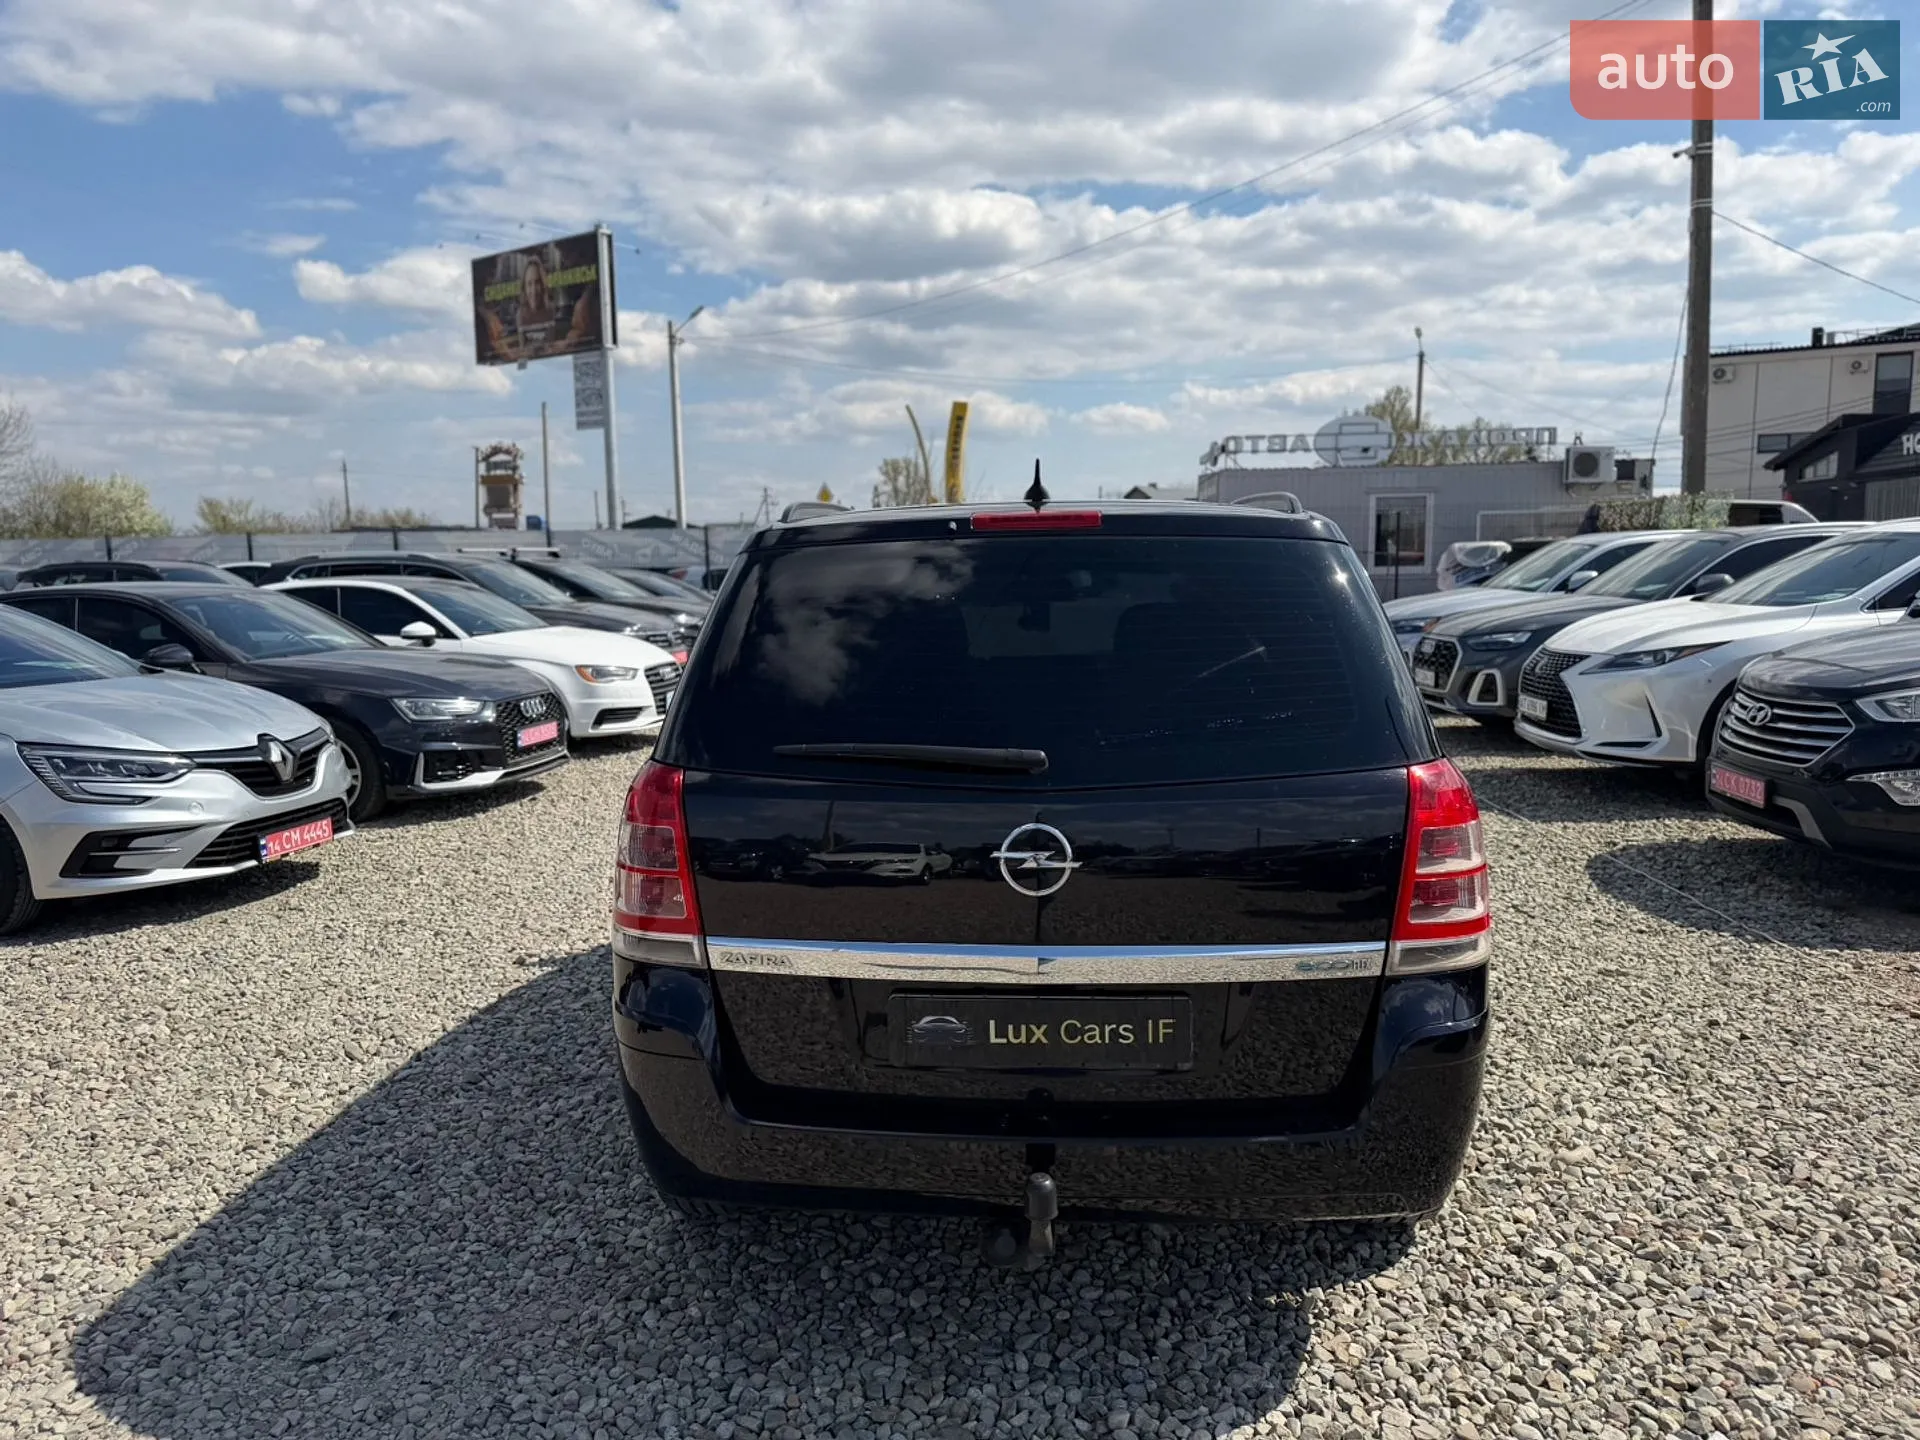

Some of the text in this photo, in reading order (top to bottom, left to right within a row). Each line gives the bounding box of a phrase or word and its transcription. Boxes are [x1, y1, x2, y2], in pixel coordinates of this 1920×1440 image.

[268, 820, 329, 854] 14 CM 4445
[720, 951, 793, 967] ZAFIRA
[988, 1019, 1176, 1044] Lux Cars IF
